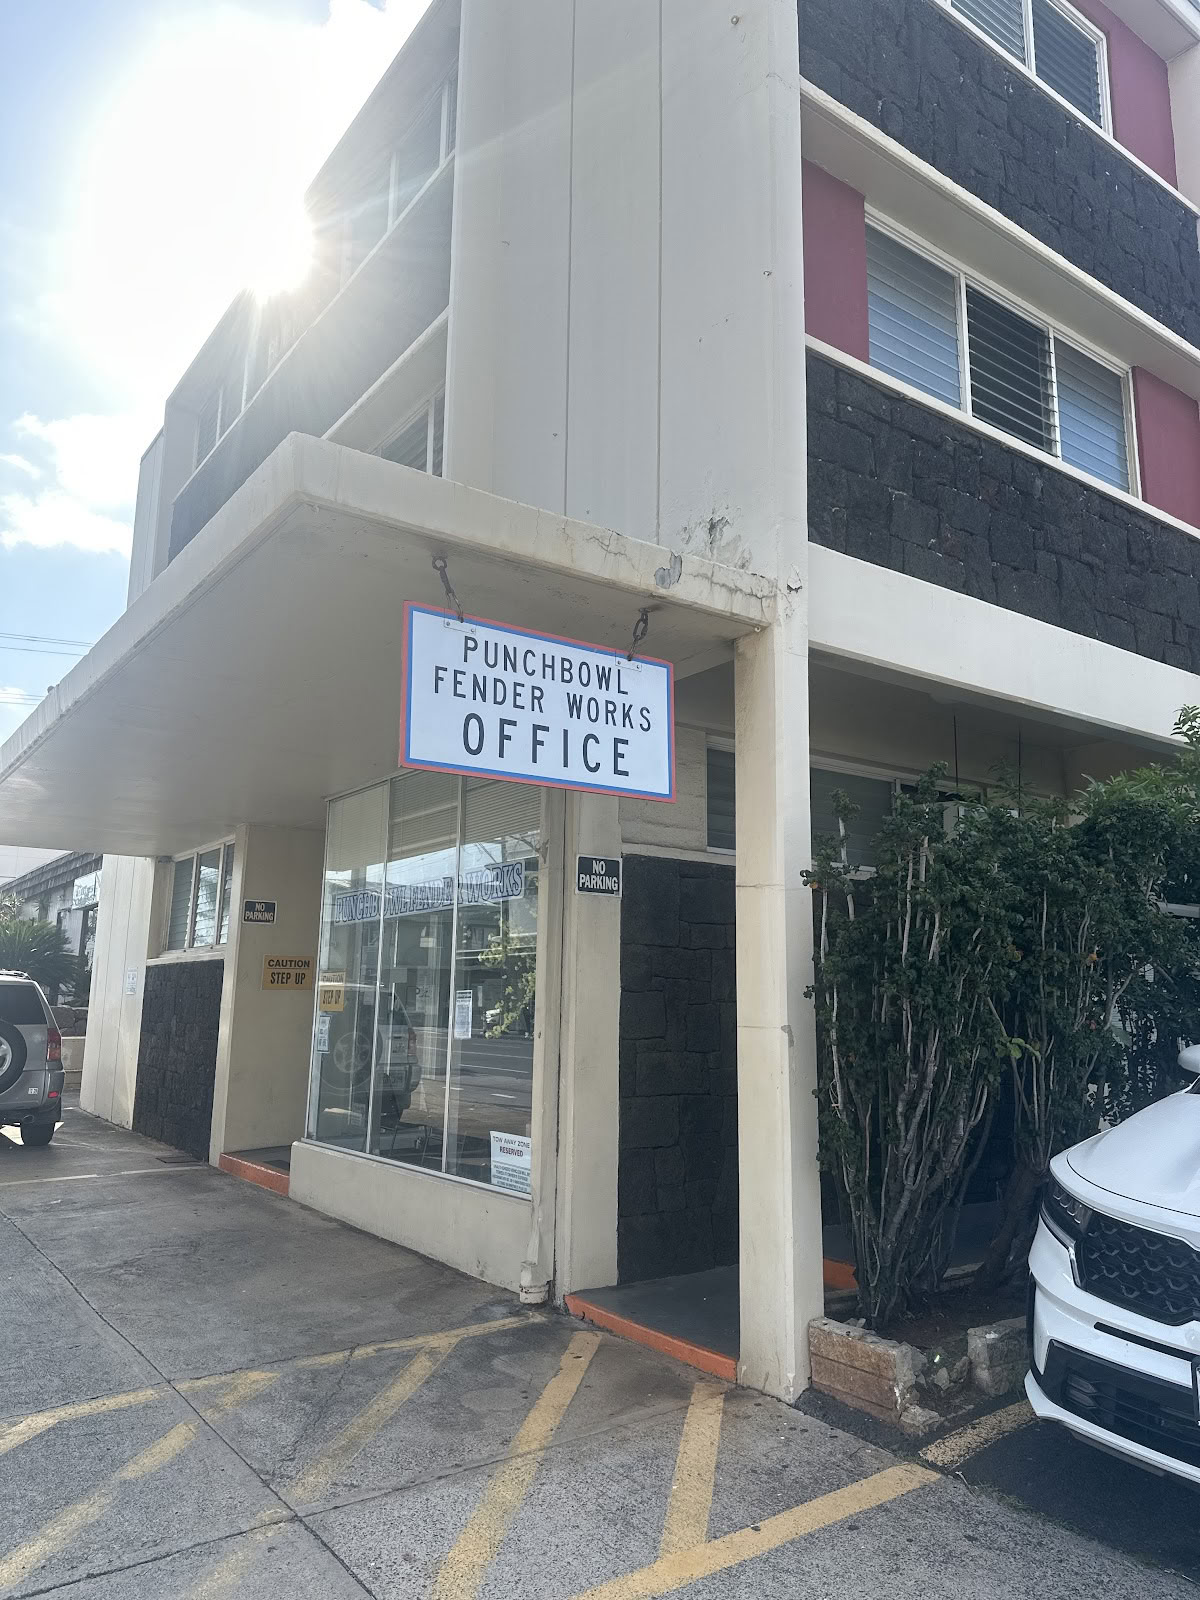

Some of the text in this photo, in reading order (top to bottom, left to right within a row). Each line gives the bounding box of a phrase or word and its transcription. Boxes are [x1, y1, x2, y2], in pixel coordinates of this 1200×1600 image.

[463, 635, 629, 695] PUNCHBOWL
[434, 665, 651, 733] FENDER WORKS
[462, 712, 630, 777] OFFICE
[592, 860, 606, 875] NO
[579, 873, 619, 891] PARKING
[335, 885, 407, 924] PUNCHBOWL
[465, 861, 522, 903] WORKS
[255, 902, 265, 912] NO
[244, 911, 274, 921] PARKING
[267, 959, 311, 968] CAUTION
[270, 971, 306, 985] STEP UP
[493, 1135, 503, 1143] TOW
[517, 1140, 530, 1149] ZONE
[499, 1146, 524, 1157] RESERVED
